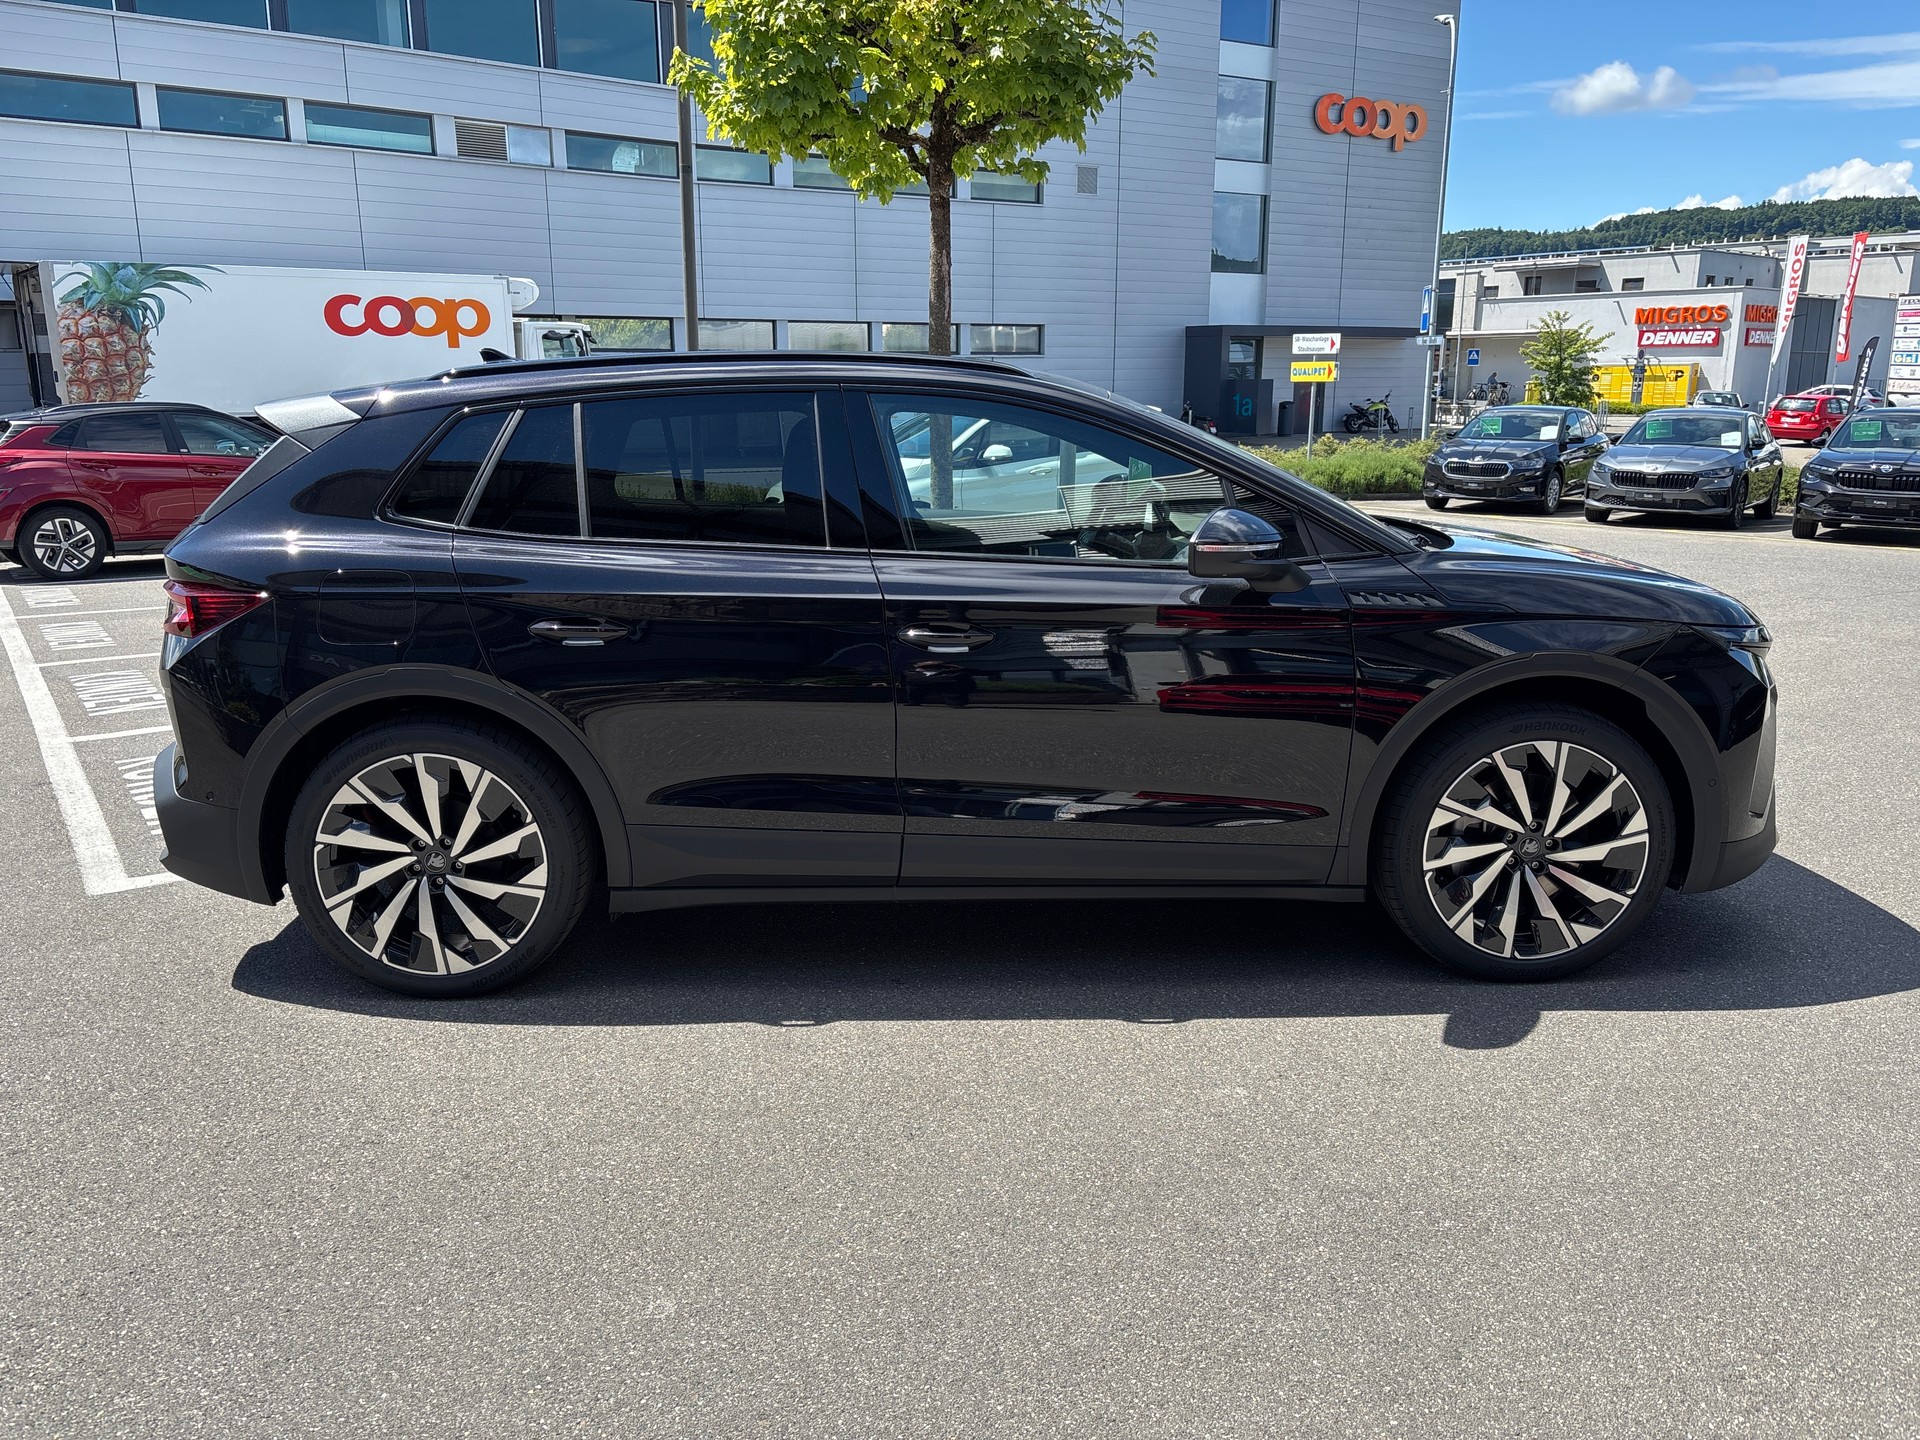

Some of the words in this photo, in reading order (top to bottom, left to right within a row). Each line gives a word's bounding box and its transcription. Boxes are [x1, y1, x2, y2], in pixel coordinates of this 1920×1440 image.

[1314, 92, 1428, 151] coop
[1782, 243, 1805, 333] MIGROS
[324, 294, 491, 348] coop
[1635, 304, 1728, 325] MIGROS
[1745, 305, 1778, 323] MIGRO
[1640, 331, 1717, 345] DENNER
[1749, 331, 1776, 344] DENNE
[1292, 367, 1327, 376] QUALIPET
[1233, 393, 1253, 417] 1a
[1523, 719, 1588, 738] Hankook
[330, 737, 389, 777] Hankook
